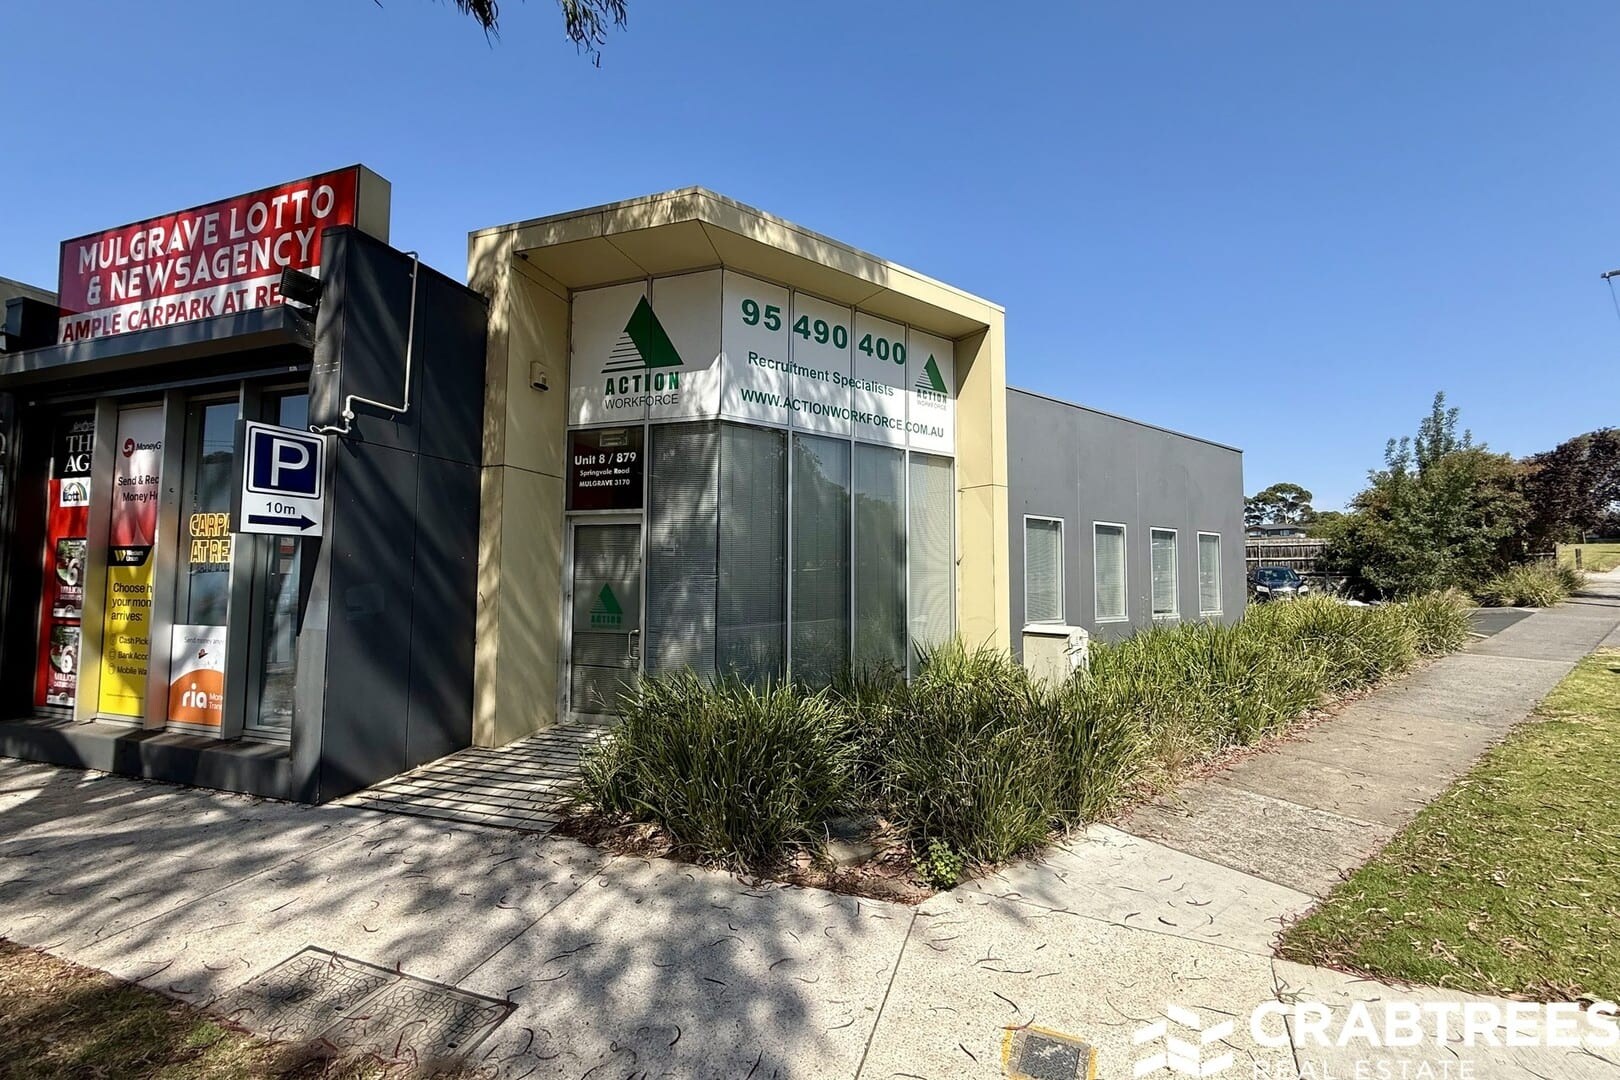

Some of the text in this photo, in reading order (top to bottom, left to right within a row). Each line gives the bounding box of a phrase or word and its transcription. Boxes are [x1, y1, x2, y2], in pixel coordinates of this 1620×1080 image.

[79, 184, 335, 275] MULGRAVE LOTTO
[86, 226, 316, 306] & NEWSAGENCY
[62, 282, 288, 343] AMPLE CARPARK AT RE
[741, 298, 906, 365] 95 490 400
[748, 351, 894, 397] Recruitment Specialists
[604, 371, 680, 396] ACTION
[604, 393, 680, 410] WORKFORCE
[916, 389, 948, 405] ACTION
[740, 388, 944, 438] WWW.ACTIONWORKFORCE.COM.AU
[270, 438, 309, 487] P
[574, 451, 637, 466] Unit 8 / 879
[580, 467, 630, 477] Springvale Road
[118, 476, 137, 486] Send
[138, 475, 144, 485] &
[579, 478, 630, 488] MULGRAVE 3170
[122, 491, 148, 503] Money
[266, 501, 296, 515] 10m
[190, 539, 209, 563] AT
[113, 582, 146, 593] Choose
[112, 597, 131, 609] your
[111, 611, 143, 622] arrives:
[119, 636, 134, 645] Cash
[118, 650, 133, 659] Bank
[117, 665, 137, 675] Mobile
[182, 682, 208, 709] ria
